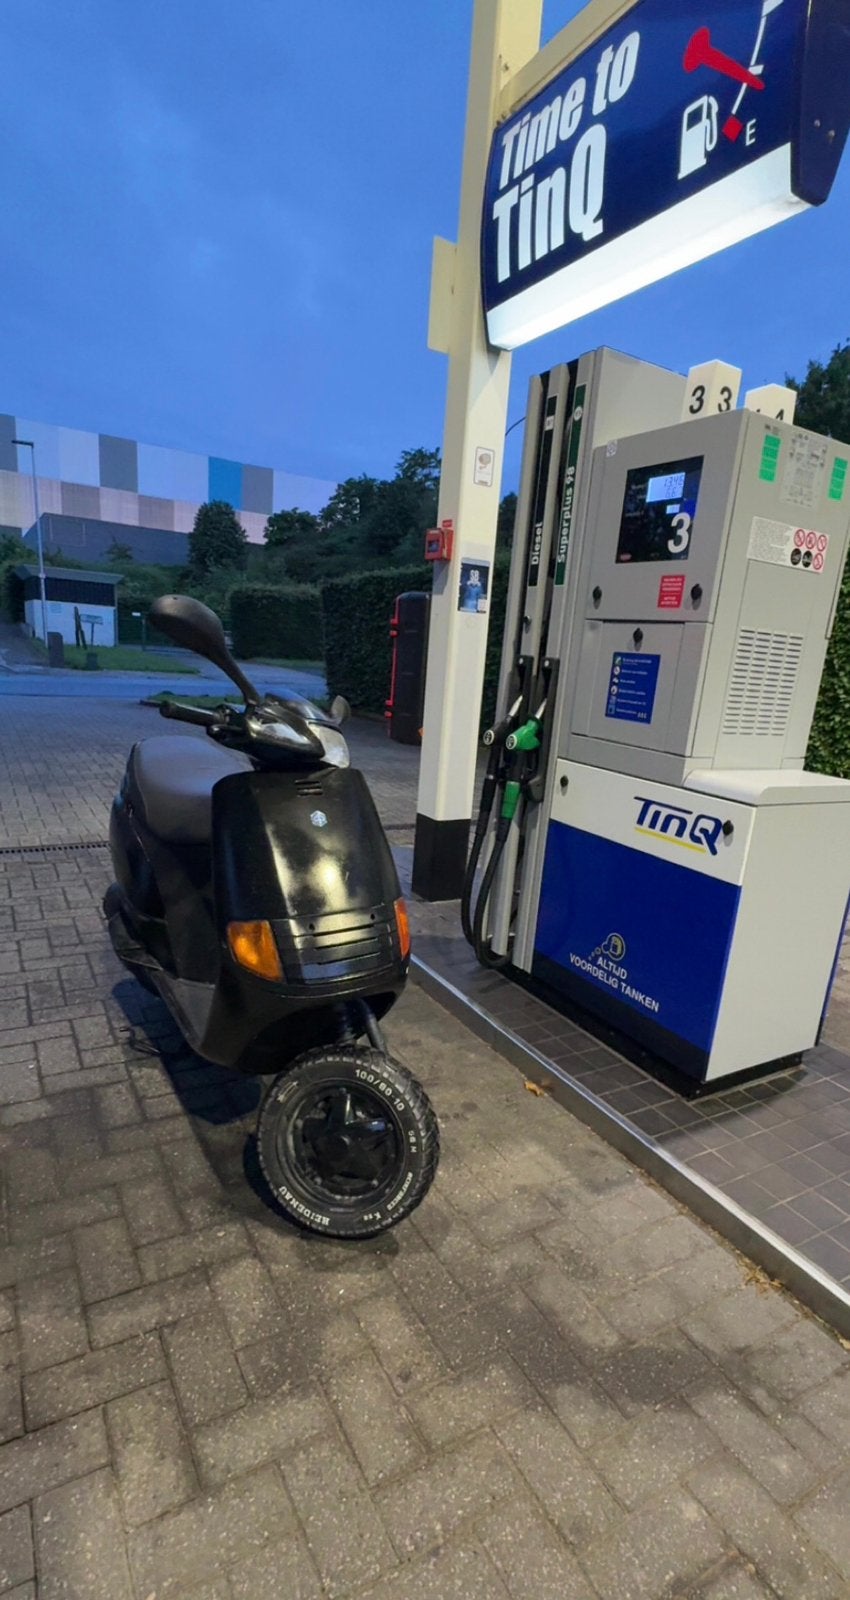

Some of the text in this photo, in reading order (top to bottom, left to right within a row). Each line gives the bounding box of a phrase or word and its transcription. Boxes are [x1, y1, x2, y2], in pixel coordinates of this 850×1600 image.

[499, 31, 640, 191] Time to
[745, 118, 757, 147] E
[493, 123, 607, 284] TinQ
[689, 385, 706, 414] 3
[718, 386, 733, 413] 3
[558, 465, 576, 564] Superplus 98
[667, 512, 692, 554] 3
[530, 521, 543, 566] Diesel
[633, 796, 723, 856] TinQ
[569, 952, 660, 1013] VOORDELIG TANKEN
[596, 956, 628, 980] ALTIJD
[279, 1185, 331, 1226] HEIDENAU
